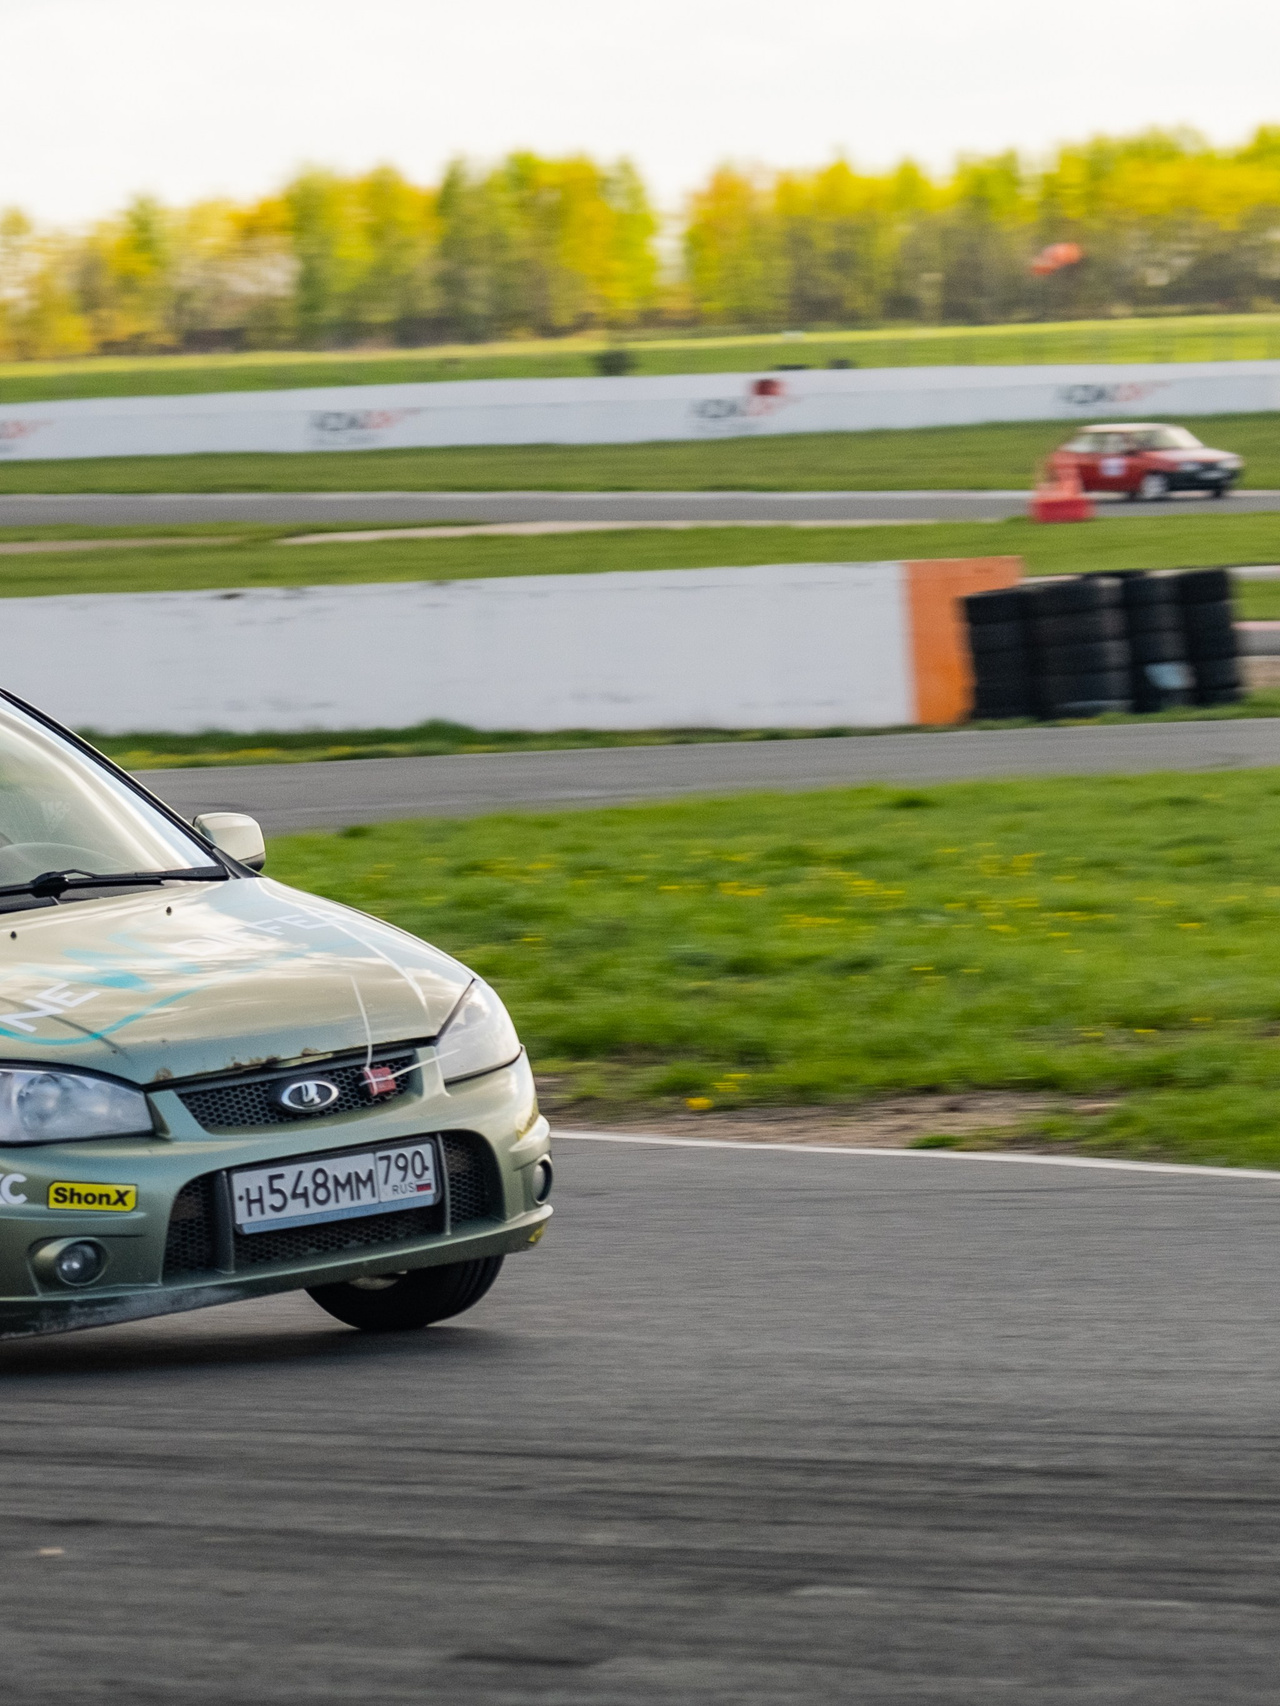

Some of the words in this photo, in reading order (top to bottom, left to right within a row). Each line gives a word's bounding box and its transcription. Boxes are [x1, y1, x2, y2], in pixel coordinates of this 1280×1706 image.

[378, 1150, 428, 1186] 790
[53, 1187, 131, 1207] ShonX
[392, 1182, 416, 1195] RUS
